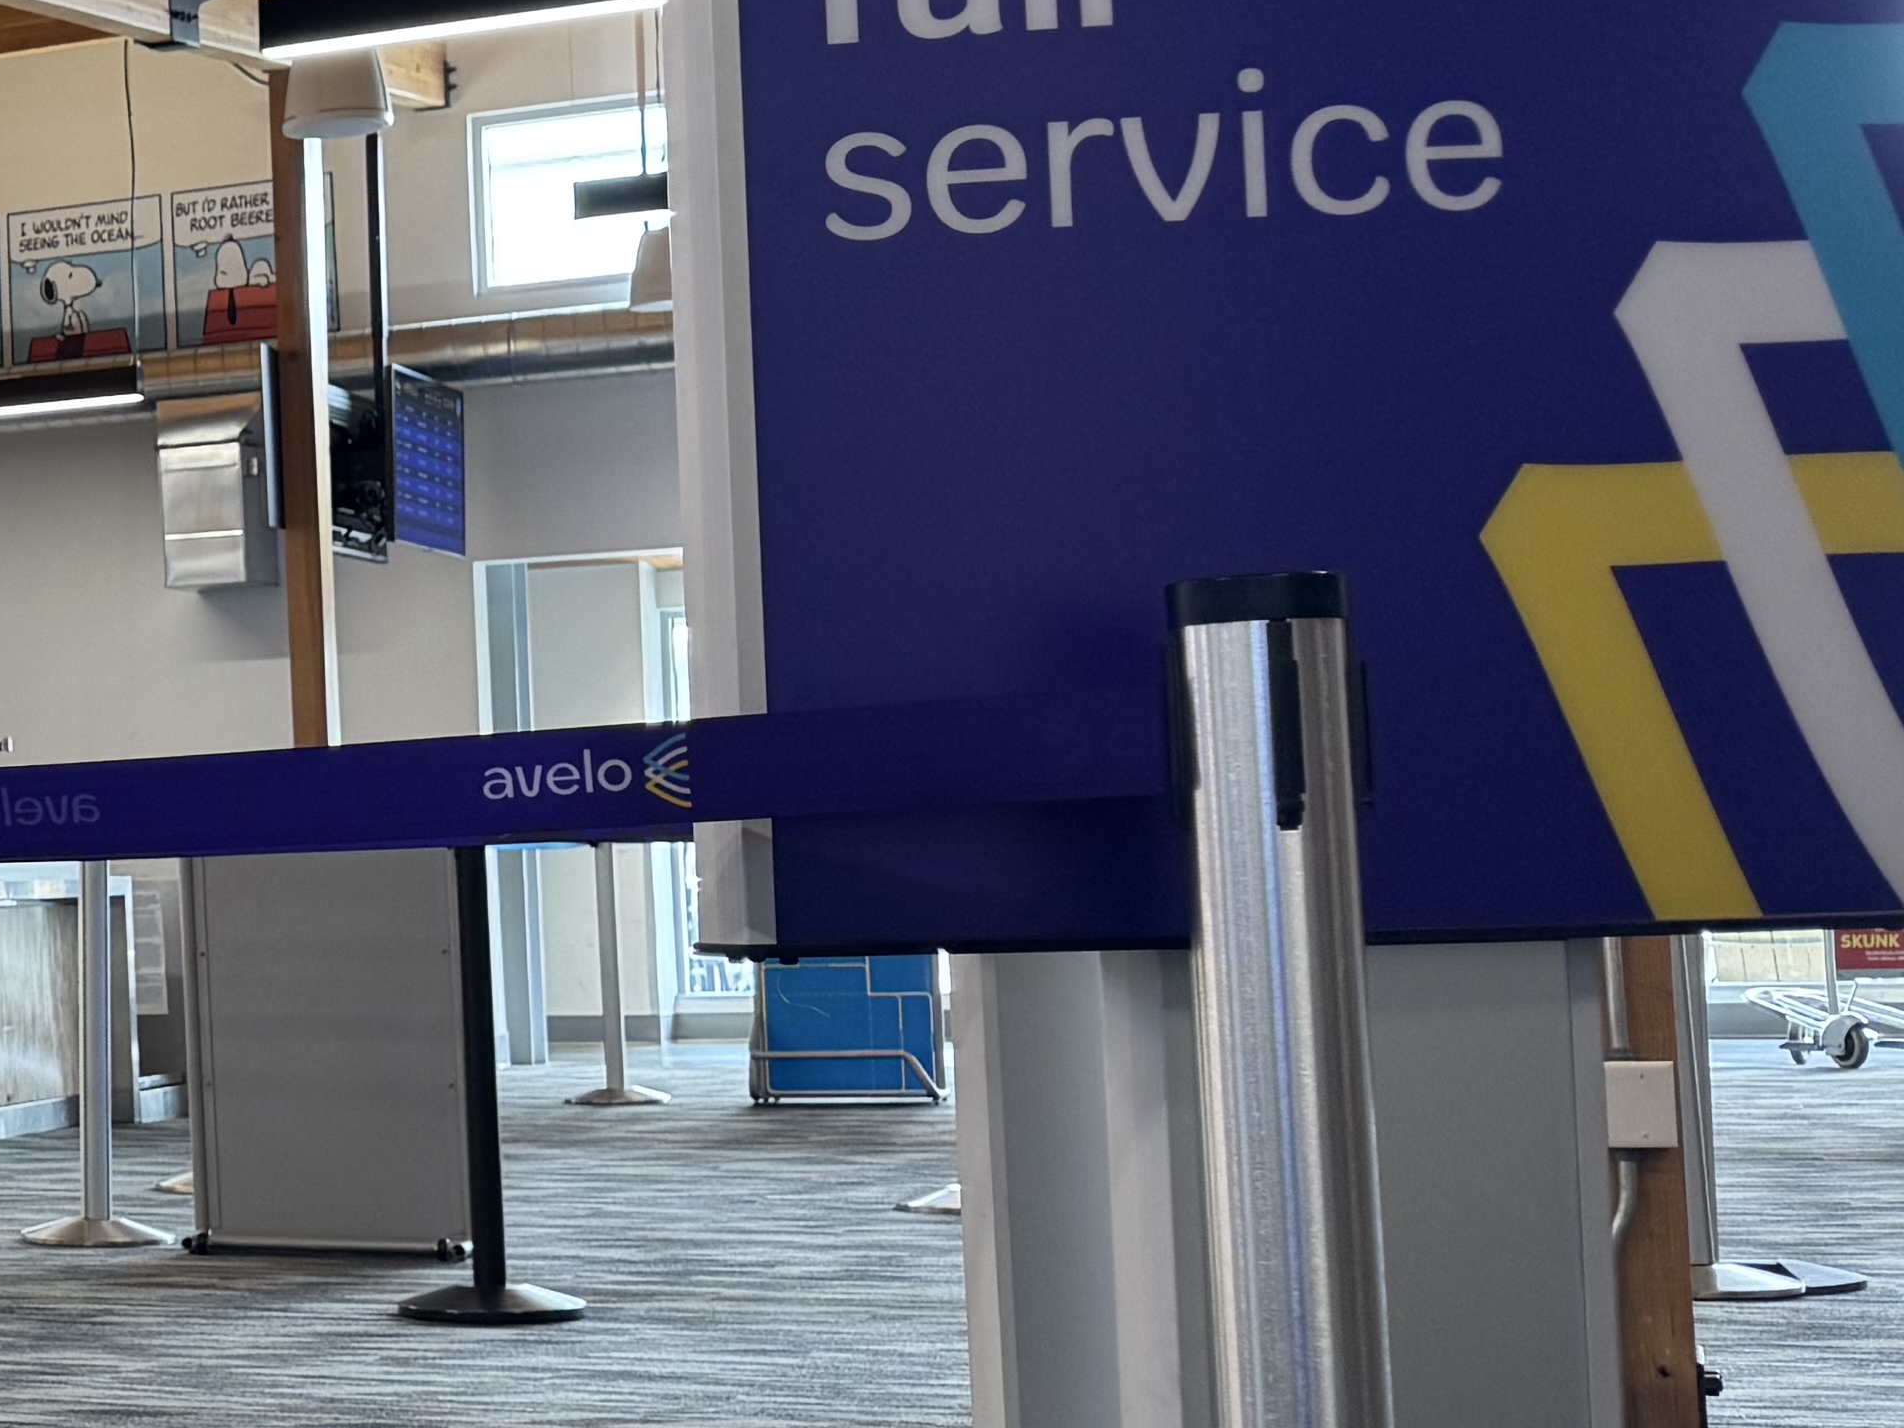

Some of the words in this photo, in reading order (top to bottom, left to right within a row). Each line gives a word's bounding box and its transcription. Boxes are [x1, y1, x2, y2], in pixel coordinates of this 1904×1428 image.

[824, 67, 1503, 241] service
[175, 201, 198, 217] BUT
[202, 196, 216, 213] I'D
[221, 192, 270, 210] RATHER
[21, 223, 26, 237] I
[32, 214, 91, 234] WOULDN'T
[95, 211, 128, 227] MIND
[190, 216, 226, 232] ROOT
[230, 209, 273, 227] BEERE
[19, 236, 60, 253] SEEING
[63, 232, 86, 247] THE
[482, 748, 633, 801] avelo
[1841, 934, 1901, 948] SKUNK
